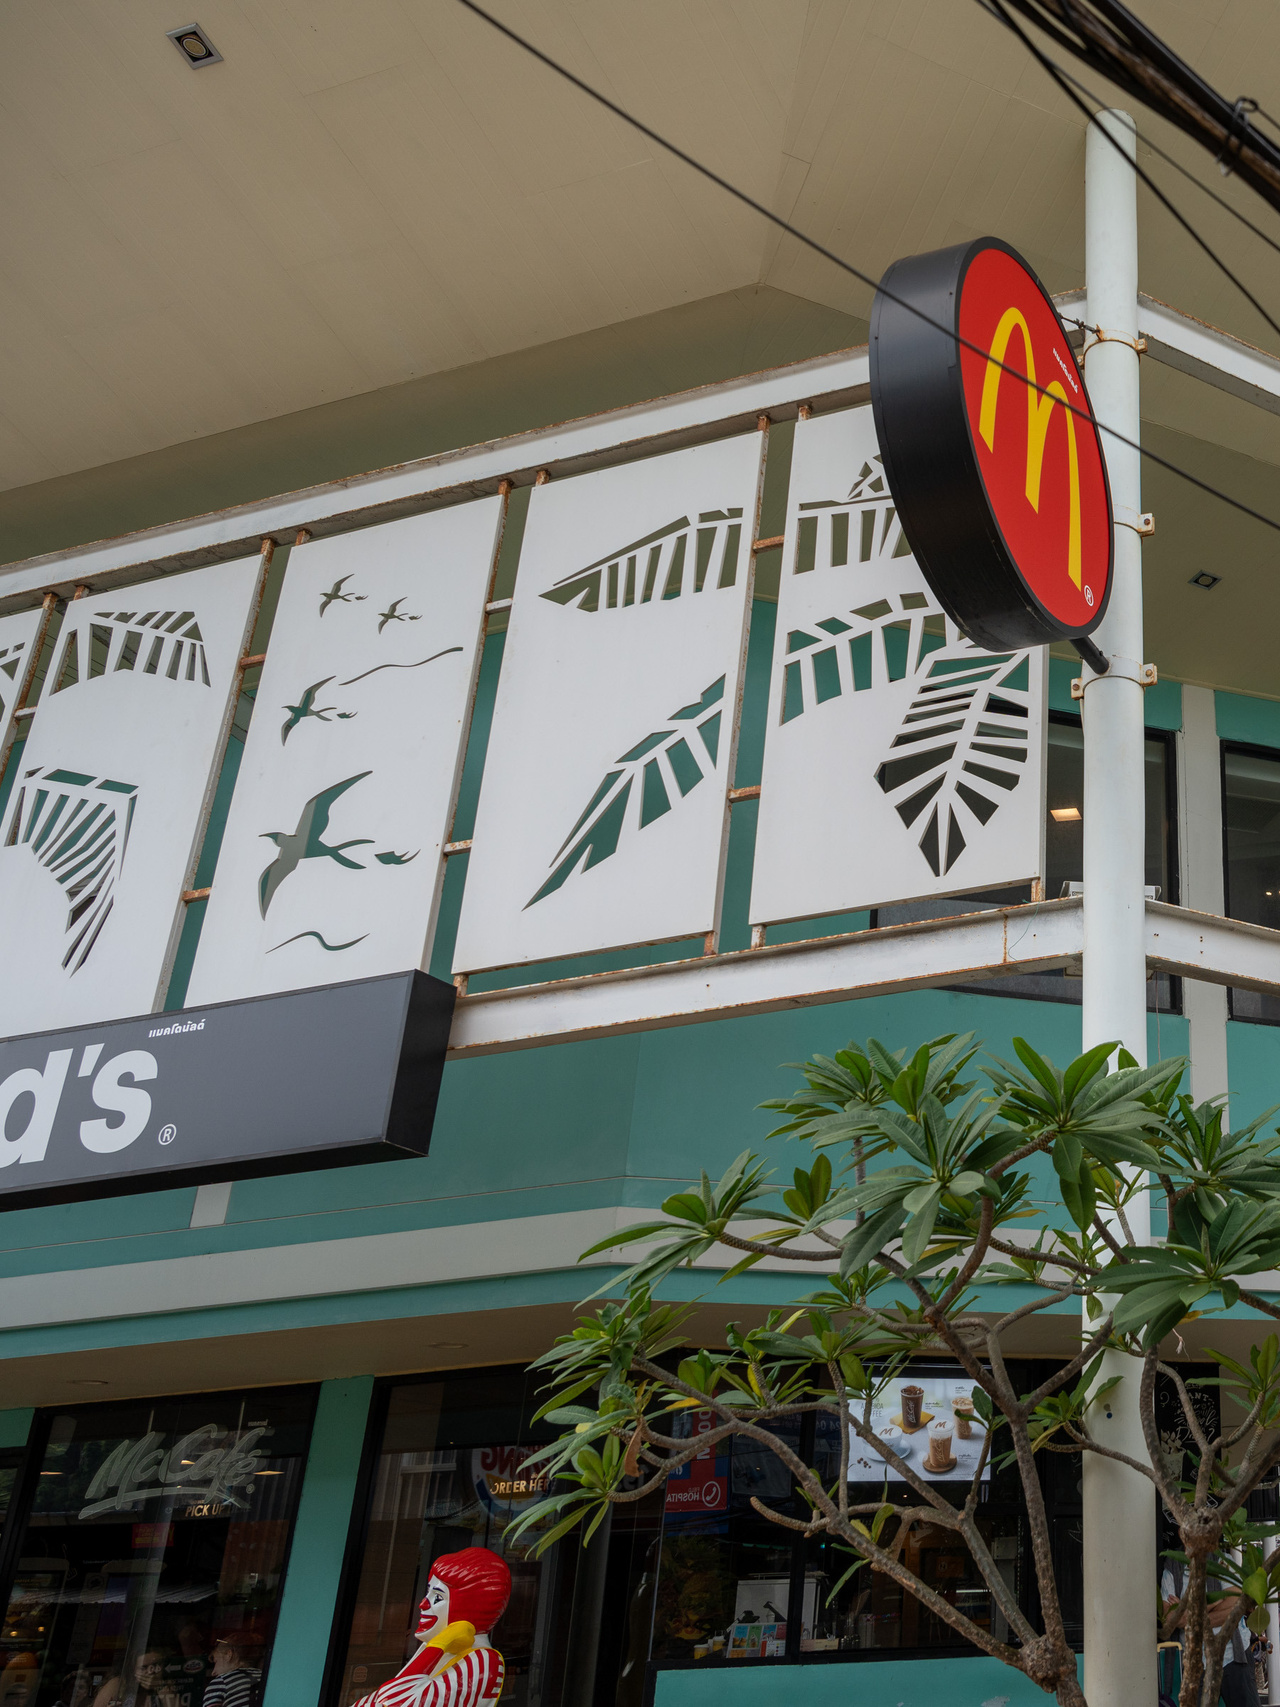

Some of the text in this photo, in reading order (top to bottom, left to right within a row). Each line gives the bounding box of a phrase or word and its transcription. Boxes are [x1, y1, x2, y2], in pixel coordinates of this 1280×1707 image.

[148, 1018, 206, 1038] แมคโดนัลด์
[489, 1480, 527, 1495] ORDER
[185, 1504, 211, 1517] PICK
